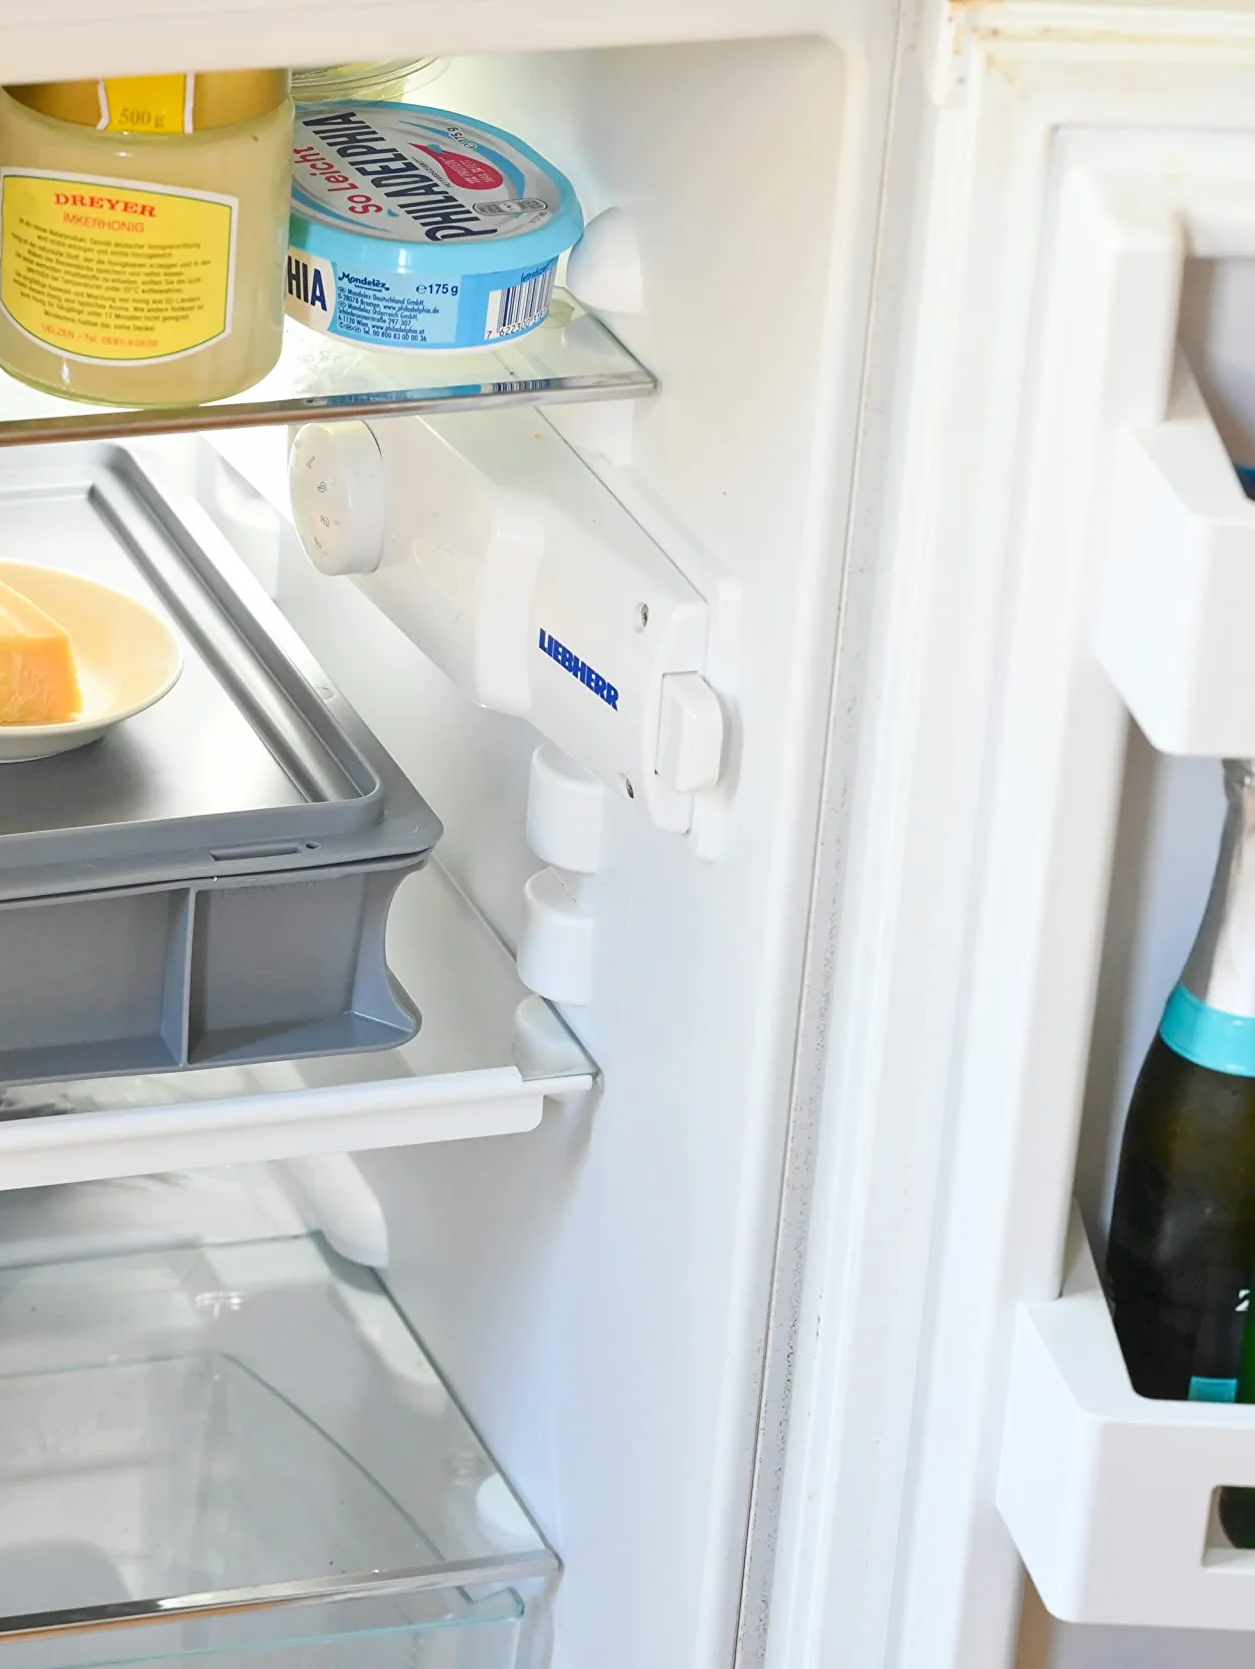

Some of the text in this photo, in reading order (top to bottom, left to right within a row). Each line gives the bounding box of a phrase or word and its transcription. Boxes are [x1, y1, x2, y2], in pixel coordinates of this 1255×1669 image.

[119, 107, 152, 126] 500
[302, 112, 498, 242] PHILADELPHIA
[54, 191, 157, 218] DREYER
[347, 194, 384, 215] So
[62, 211, 145, 234] IMKERHONIG
[538, 627, 620, 712] LIEBHERR
